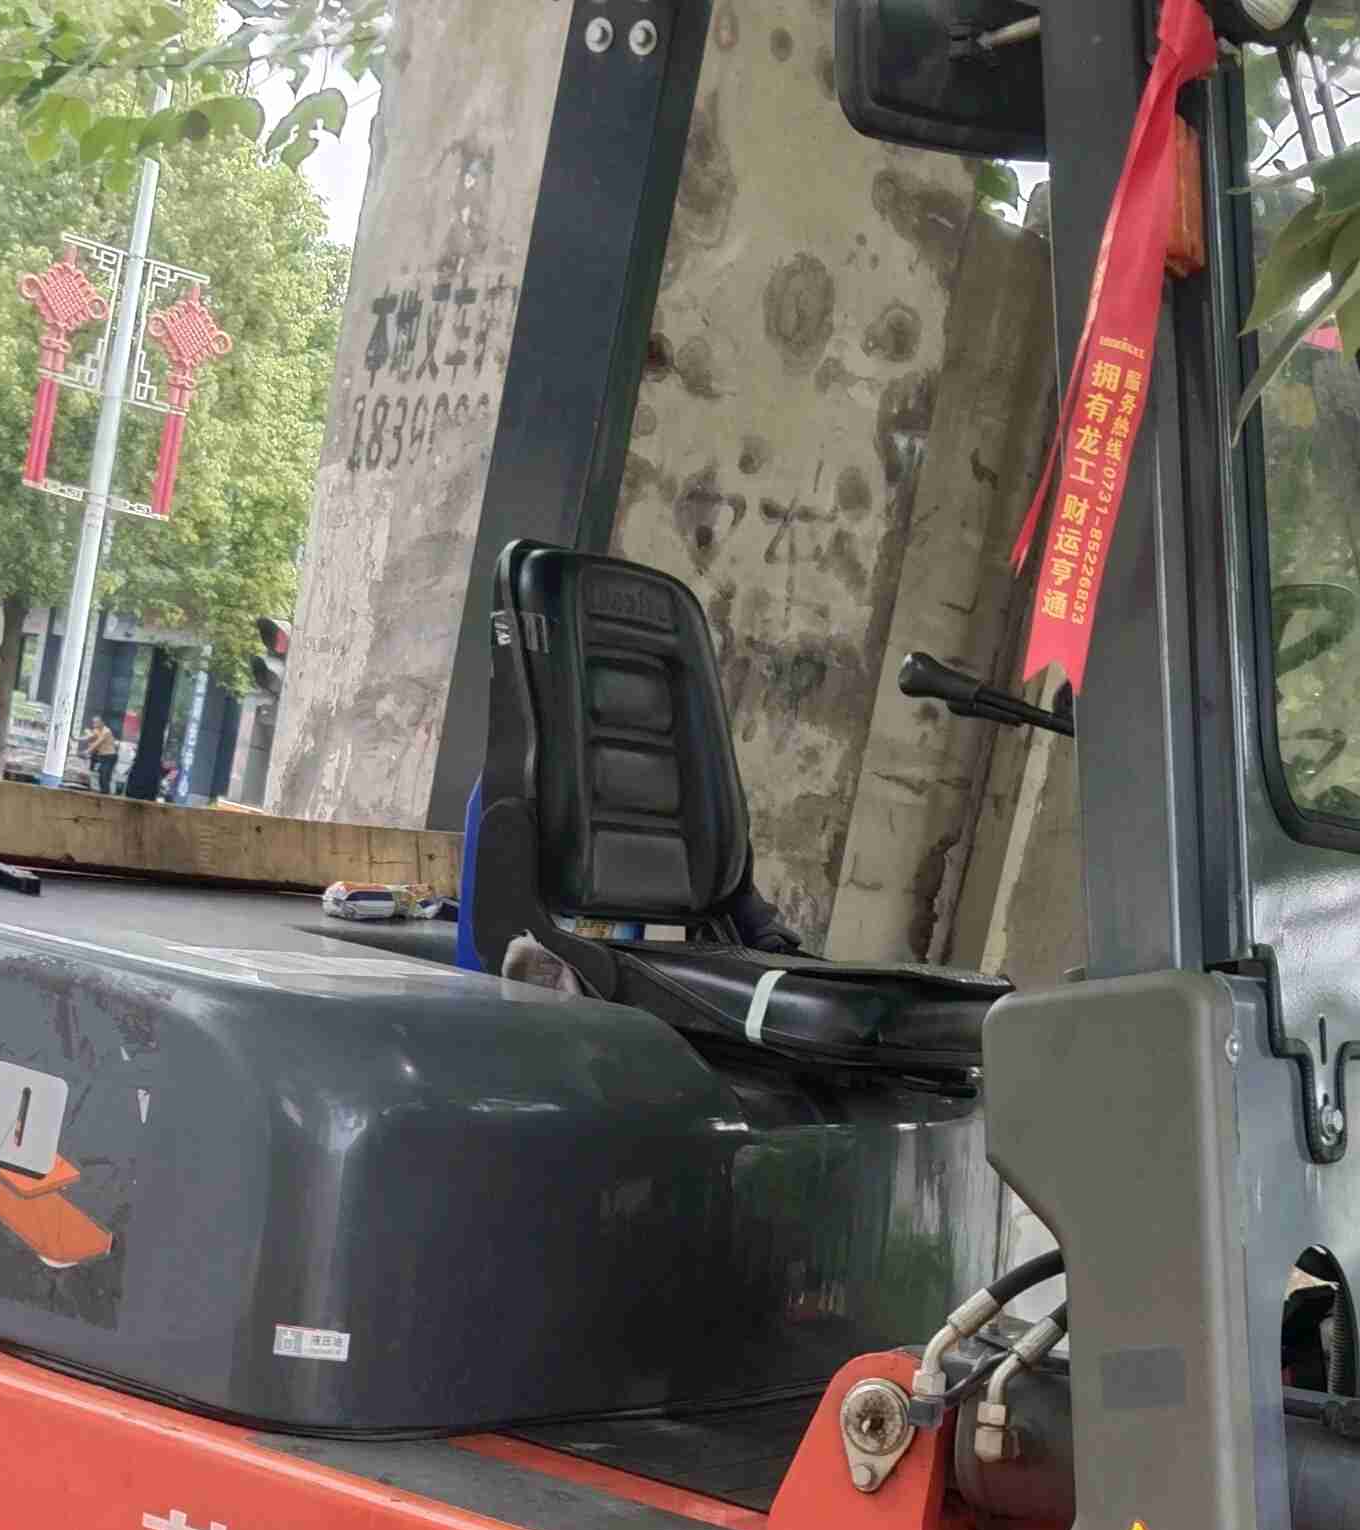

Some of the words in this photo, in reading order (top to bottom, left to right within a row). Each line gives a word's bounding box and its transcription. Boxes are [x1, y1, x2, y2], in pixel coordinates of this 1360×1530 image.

[1070, 360, 1122, 485] 拥有龙工
[1041, 494, 1089, 620] 财运亨通
